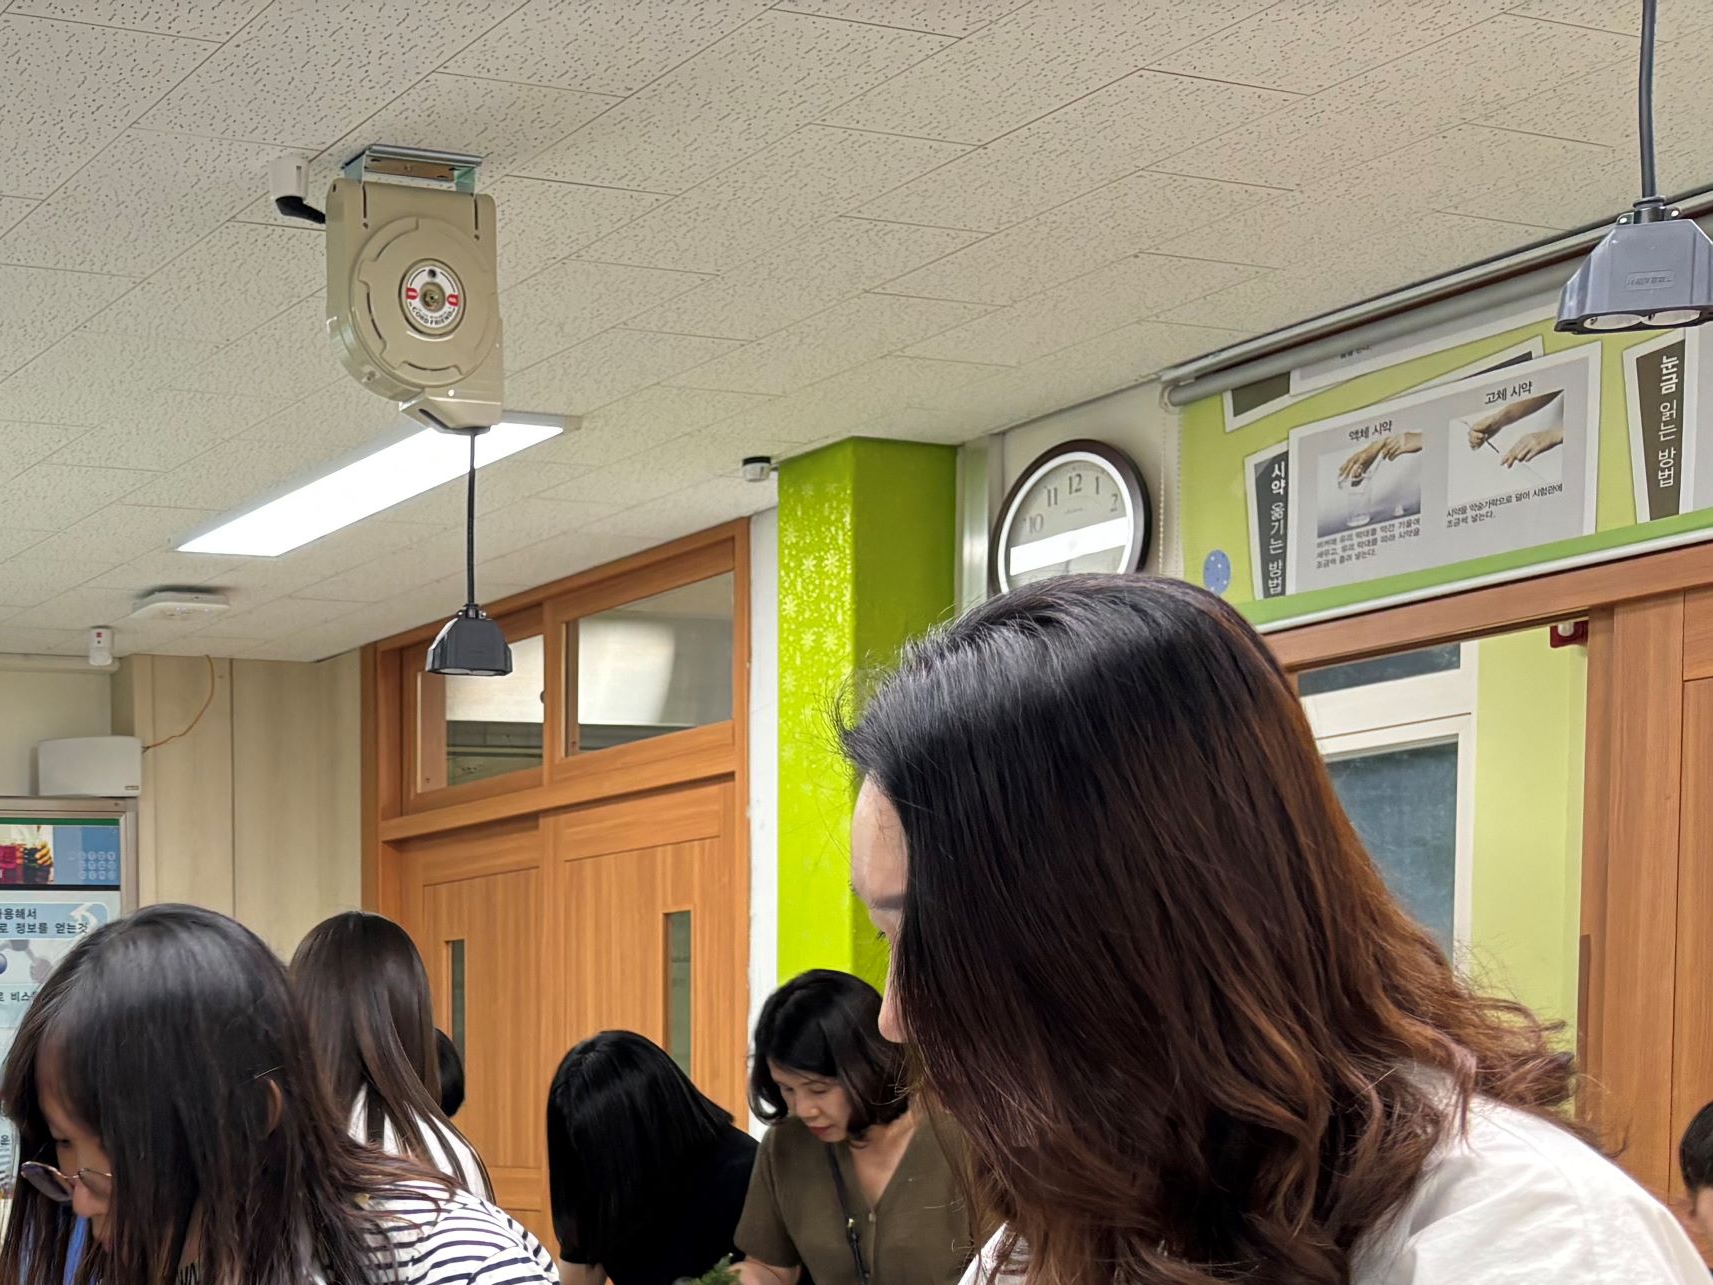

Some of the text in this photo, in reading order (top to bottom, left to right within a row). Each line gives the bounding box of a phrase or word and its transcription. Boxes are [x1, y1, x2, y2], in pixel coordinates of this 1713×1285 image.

[1484, 381, 1532, 404] 고체 시약
[1348, 420, 1393, 443] 액체 시약
[1658, 355, 1679, 488] 눈금 읽는 방법
[1068, 473, 1082, 495] 12
[1095, 476, 1100, 495] 1
[1047, 488, 1058, 507] 11
[1110, 493, 1119, 512] 2
[1029, 513, 1044, 535] 10
[1268, 461, 1286, 594] 시약 옮기는 방법
[15, 922, 48, 934] 정보를
